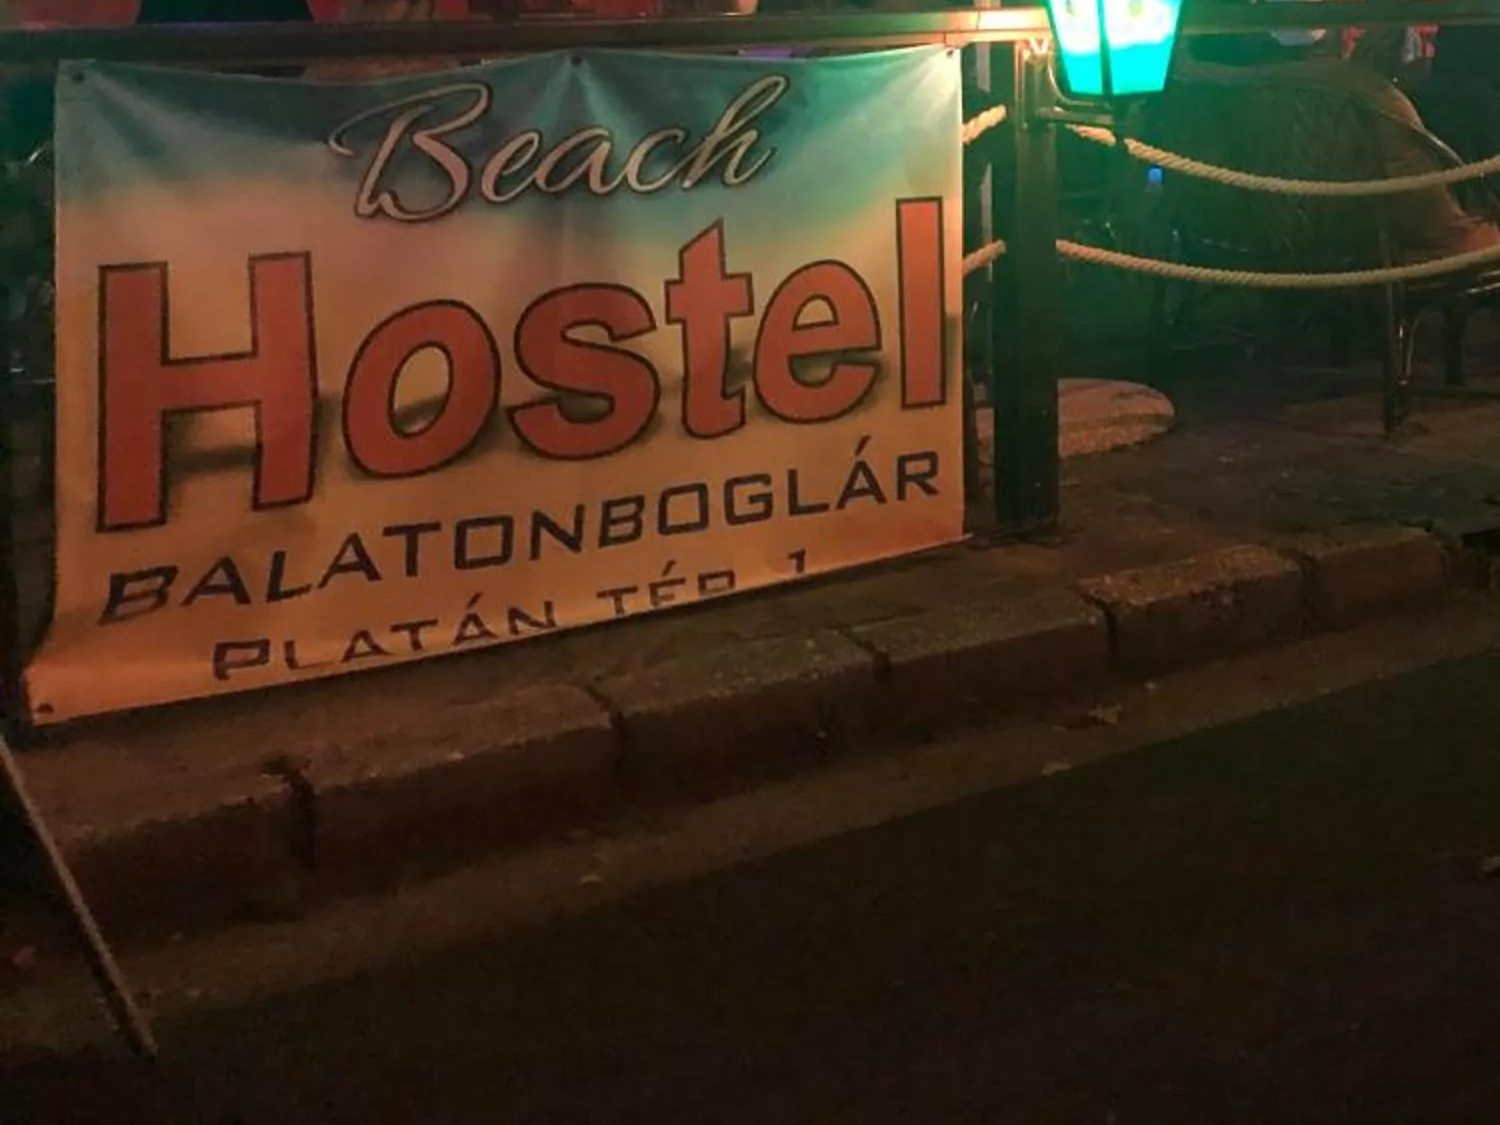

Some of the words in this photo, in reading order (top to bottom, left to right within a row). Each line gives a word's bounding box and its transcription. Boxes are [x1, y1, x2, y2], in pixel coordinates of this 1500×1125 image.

[328, 74, 790, 223] Beach
[95, 195, 948, 534] Hostel
[98, 437, 940, 625] BALATONBOGLÁR
[212, 591, 558, 681] PLATÁN
